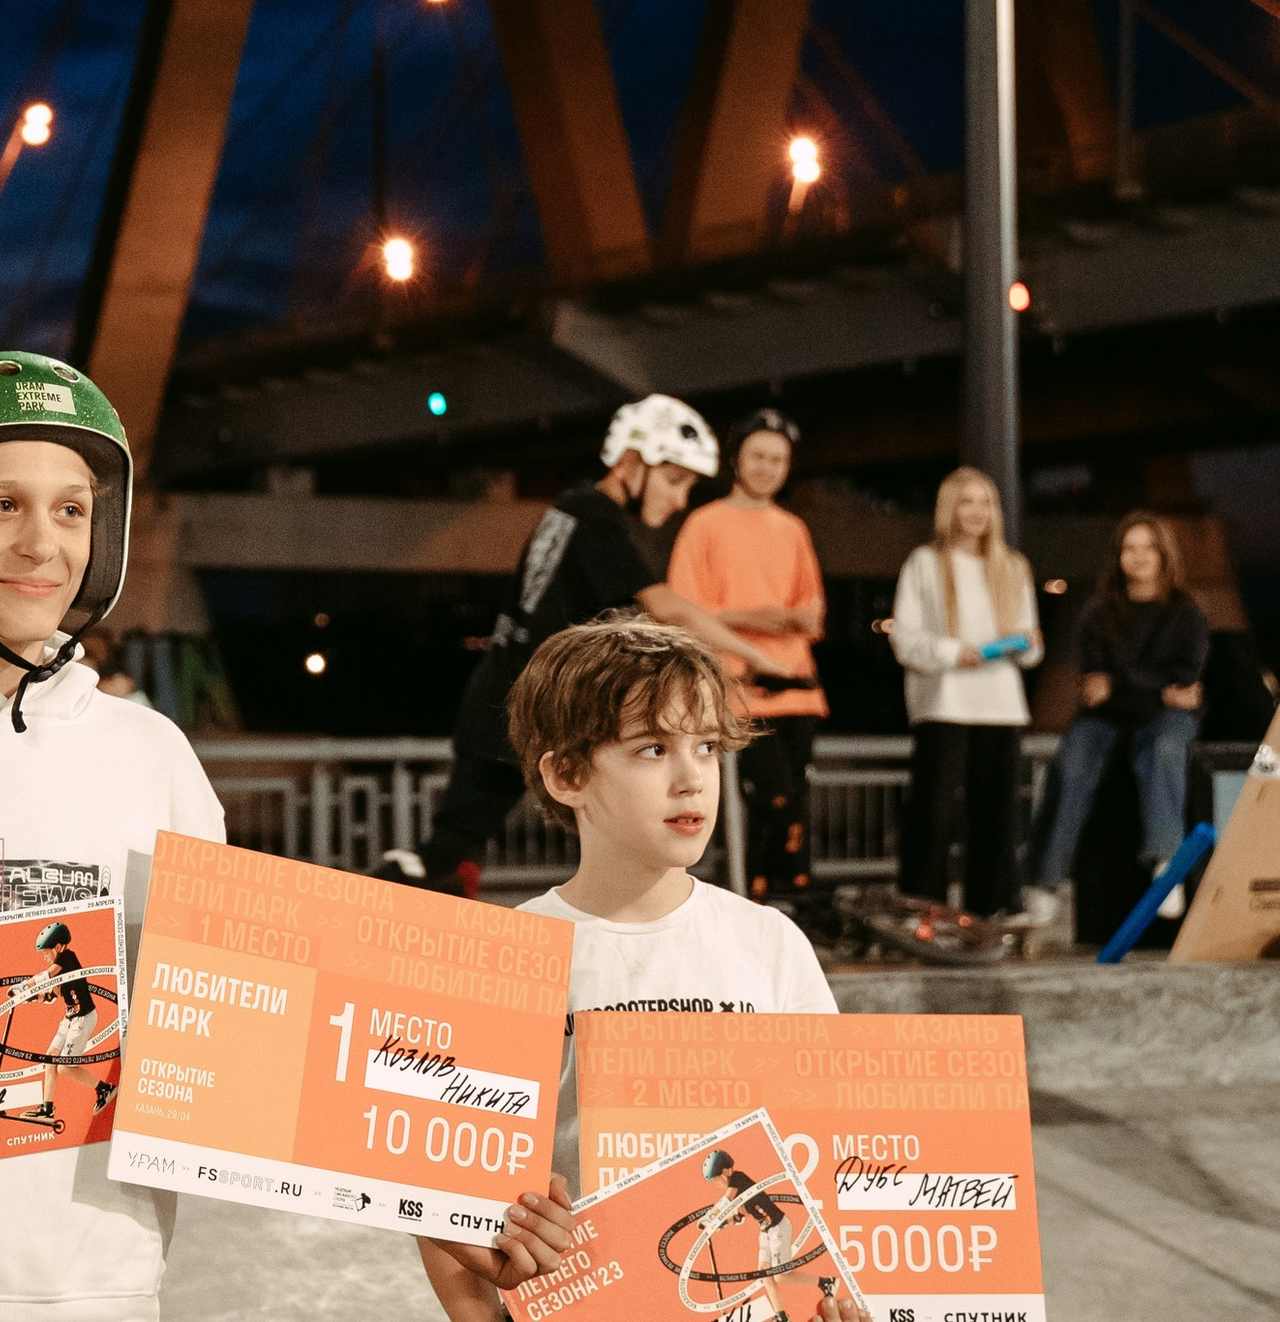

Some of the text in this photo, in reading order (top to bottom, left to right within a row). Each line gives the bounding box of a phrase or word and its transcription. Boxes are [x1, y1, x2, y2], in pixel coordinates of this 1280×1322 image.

[17, 391, 62, 403] EXTREME
[19, 401, 46, 410] PARK
[295, 865, 394, 913] СЕЗОНА
[454, 901, 552, 947] КАЗАНЬ
[233, 886, 302, 929] ПАРК
[356, 914, 492, 969] ОТКРЫТИЕ
[497, 944, 571, 986] СЕЗО
[200, 914, 211, 944] 1
[222, 919, 311, 965] МЕСТО
[387, 955, 528, 1010] ЛЮБИТЕЛИ
[151, 962, 289, 1016] ЛЮБИТЕЛИ
[147, 999, 214, 1038] ПАРК
[895, 1016, 998, 1044] КАЗАНЬ
[329, 1001, 453, 1083] 1 МЕСТО
[140, 1057, 216, 1088] ОТКРЫТИЕ
[664, 1047, 736, 1076] ПАРК
[794, 1049, 939, 1077] ОТКРЫТИЕ
[137, 1077, 194, 1104] СЕЗОНА
[632, 1079, 648, 1107] 2
[658, 1079, 751, 1107] МЕСТО
[835, 1082, 986, 1110] ЛЮБИТЕЛИ
[7, 1130, 56, 1147] СПУТНИК
[363, 1104, 412, 1156] 10
[832, 1134, 920, 1161] МЕСТО
[398, 1198, 424, 1218] KSS
[449, 1212, 505, 1234] СПУТН
